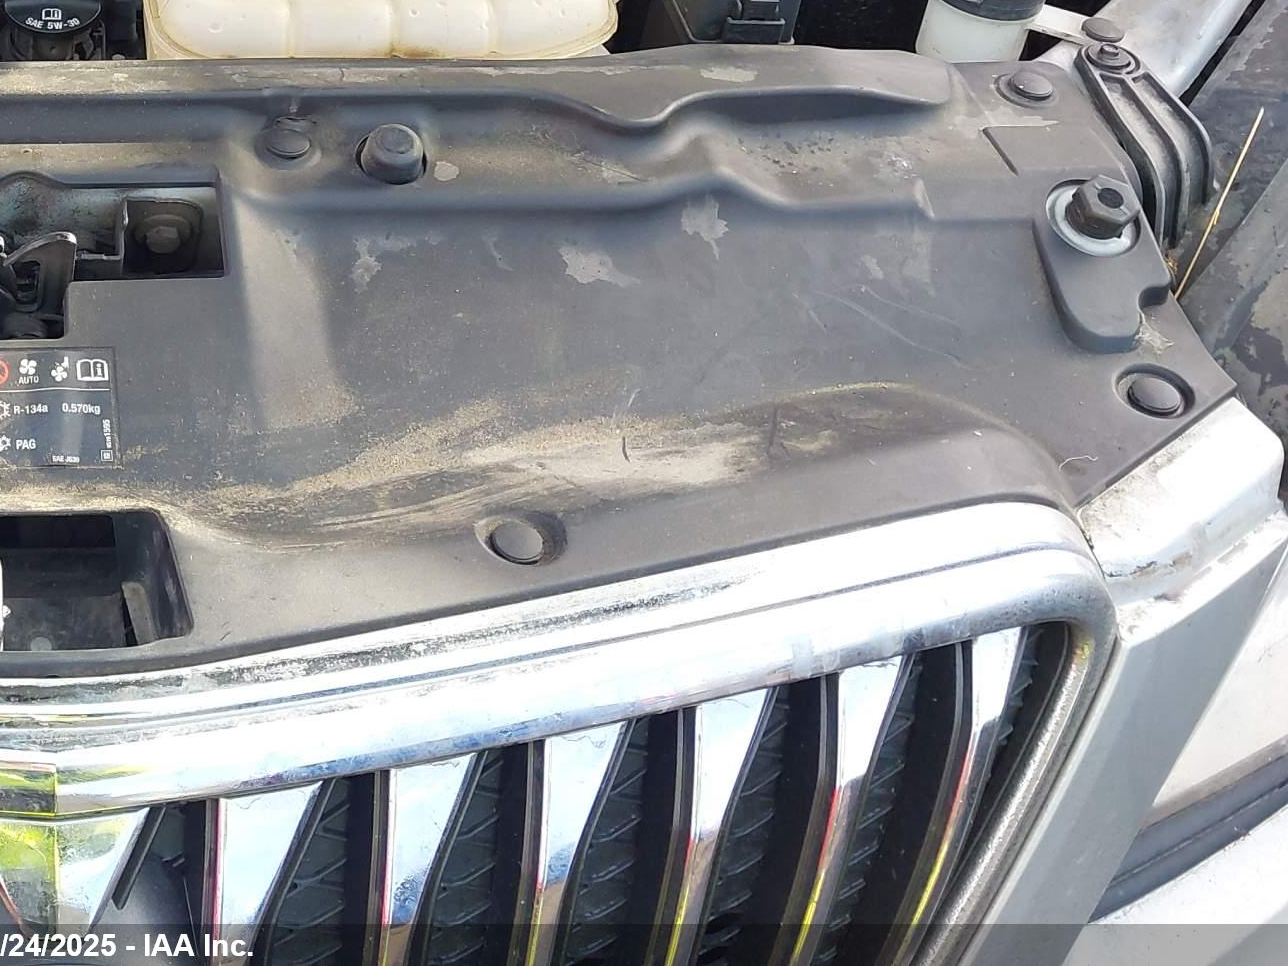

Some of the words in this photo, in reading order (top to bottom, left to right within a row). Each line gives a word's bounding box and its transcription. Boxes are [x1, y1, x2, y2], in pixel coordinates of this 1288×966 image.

[25, 17, 44, 29] SAE
[47, 17, 81, 30] 5W-30
[18, 375, 40, 385] AUTO
[13, 403, 49, 415] R-134a
[62, 402, 101, 415] 0.570kg
[15, 438, 37, 450] PAG
